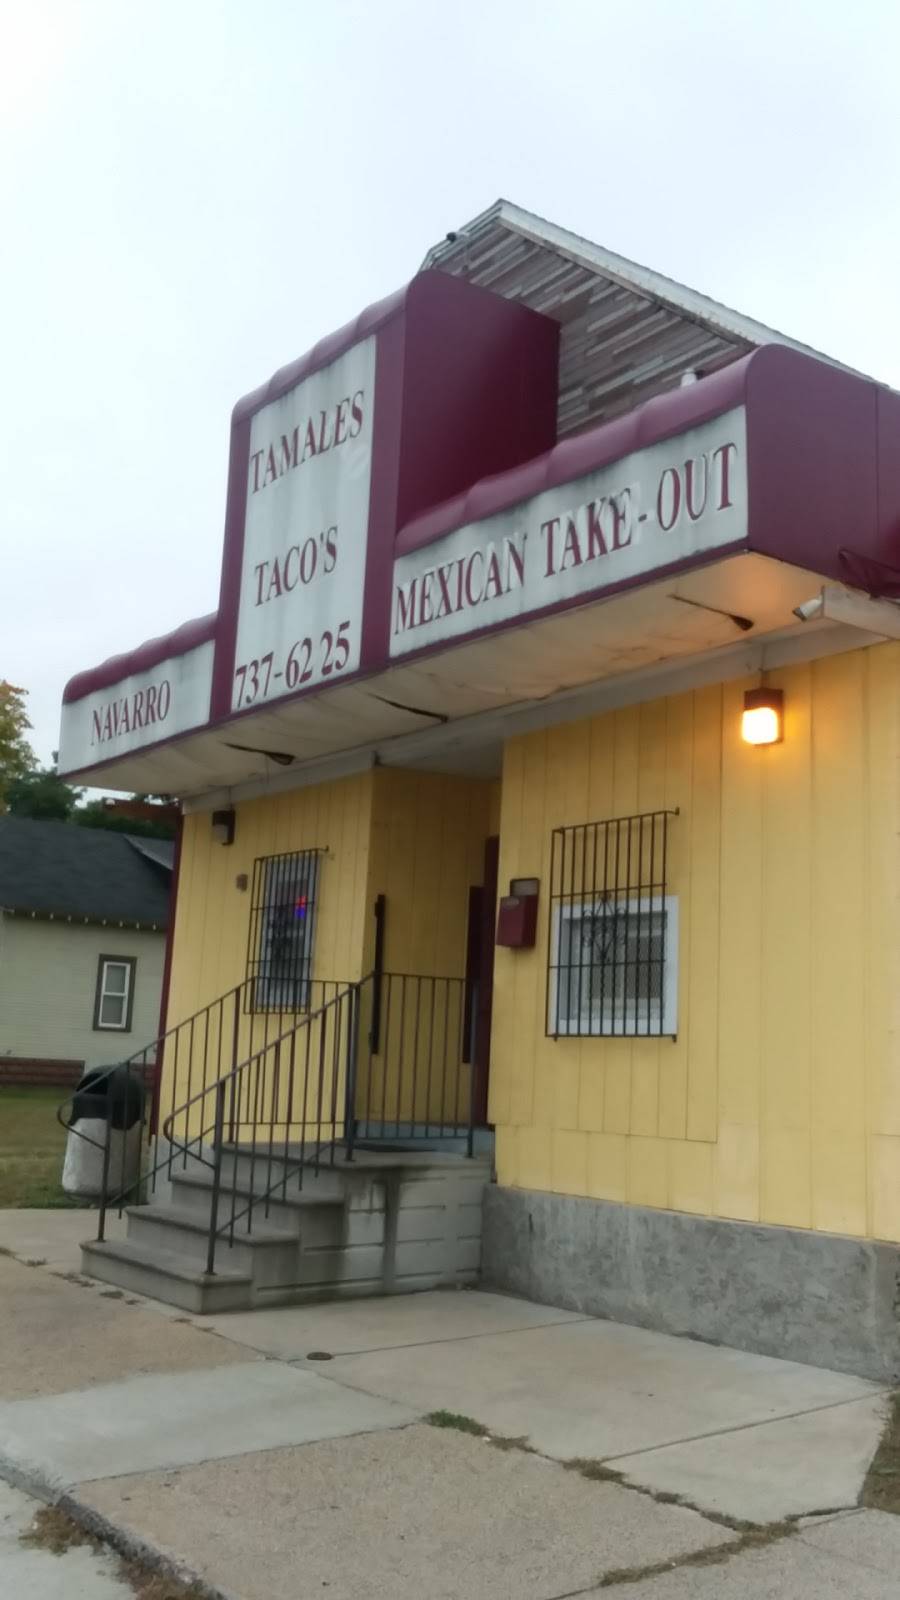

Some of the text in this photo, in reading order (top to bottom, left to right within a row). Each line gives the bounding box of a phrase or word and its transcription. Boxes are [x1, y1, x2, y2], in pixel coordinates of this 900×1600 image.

[251, 390, 365, 494] TAMALES
[254, 526, 339, 607] TACO'S
[394, 532, 527, 635] MEXICAN
[90, 679, 171, 746] NAVARRO
